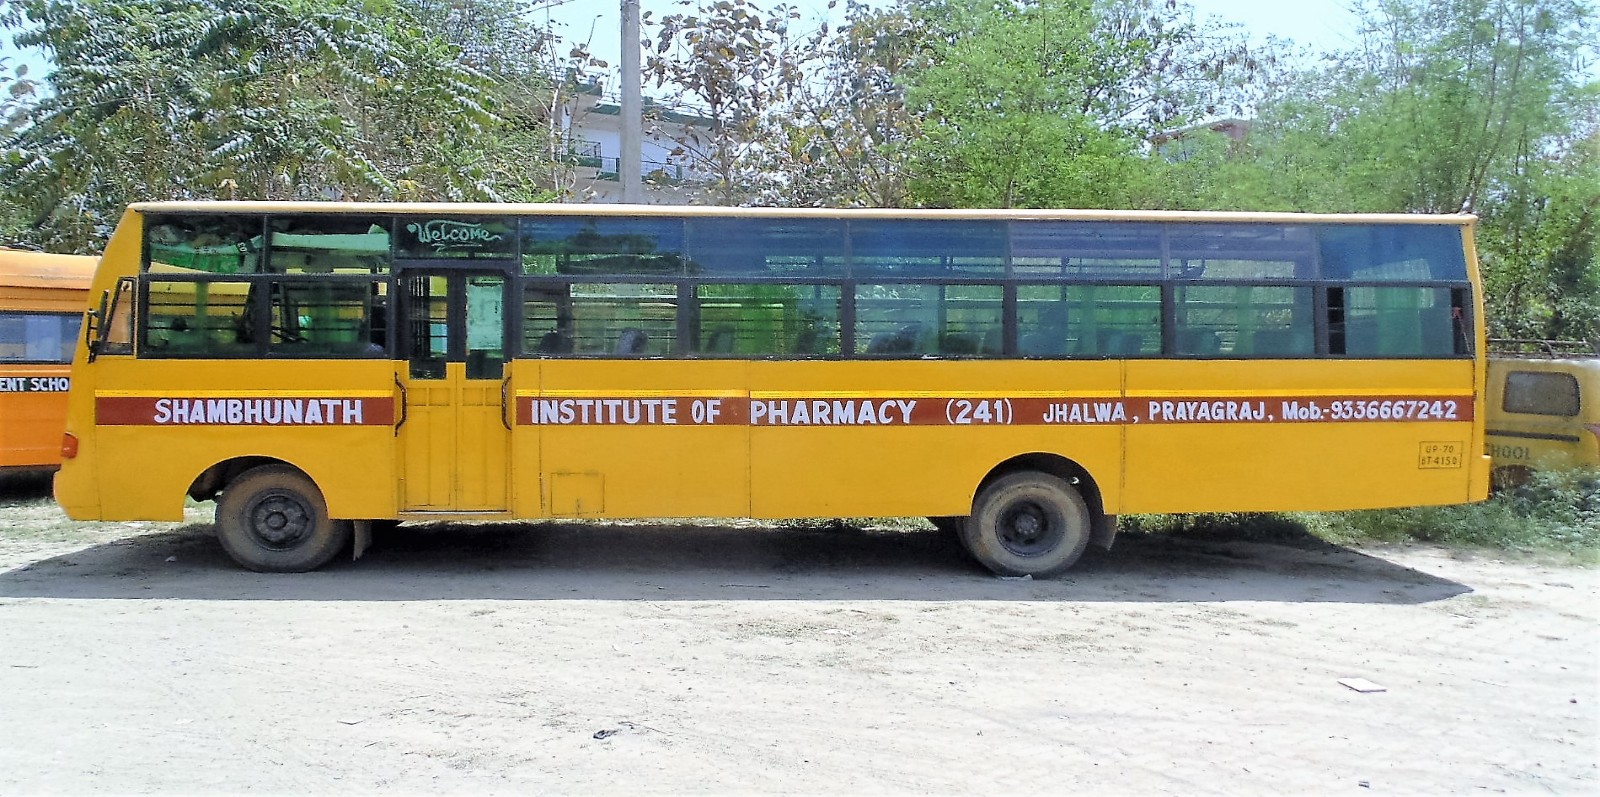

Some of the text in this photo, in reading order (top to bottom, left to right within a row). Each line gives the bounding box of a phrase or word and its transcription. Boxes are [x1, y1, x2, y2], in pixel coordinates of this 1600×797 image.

[154, 399, 363, 423] SHAMBHUNATH
[531, 400, 677, 424] INSTITUTE
[692, 400, 721, 423] OF
[750, 400, 916, 424] PHARMACY
[947, 399, 1013, 424] (241)
[1149, 401, 1274, 421] PRAYAGRAJ,
